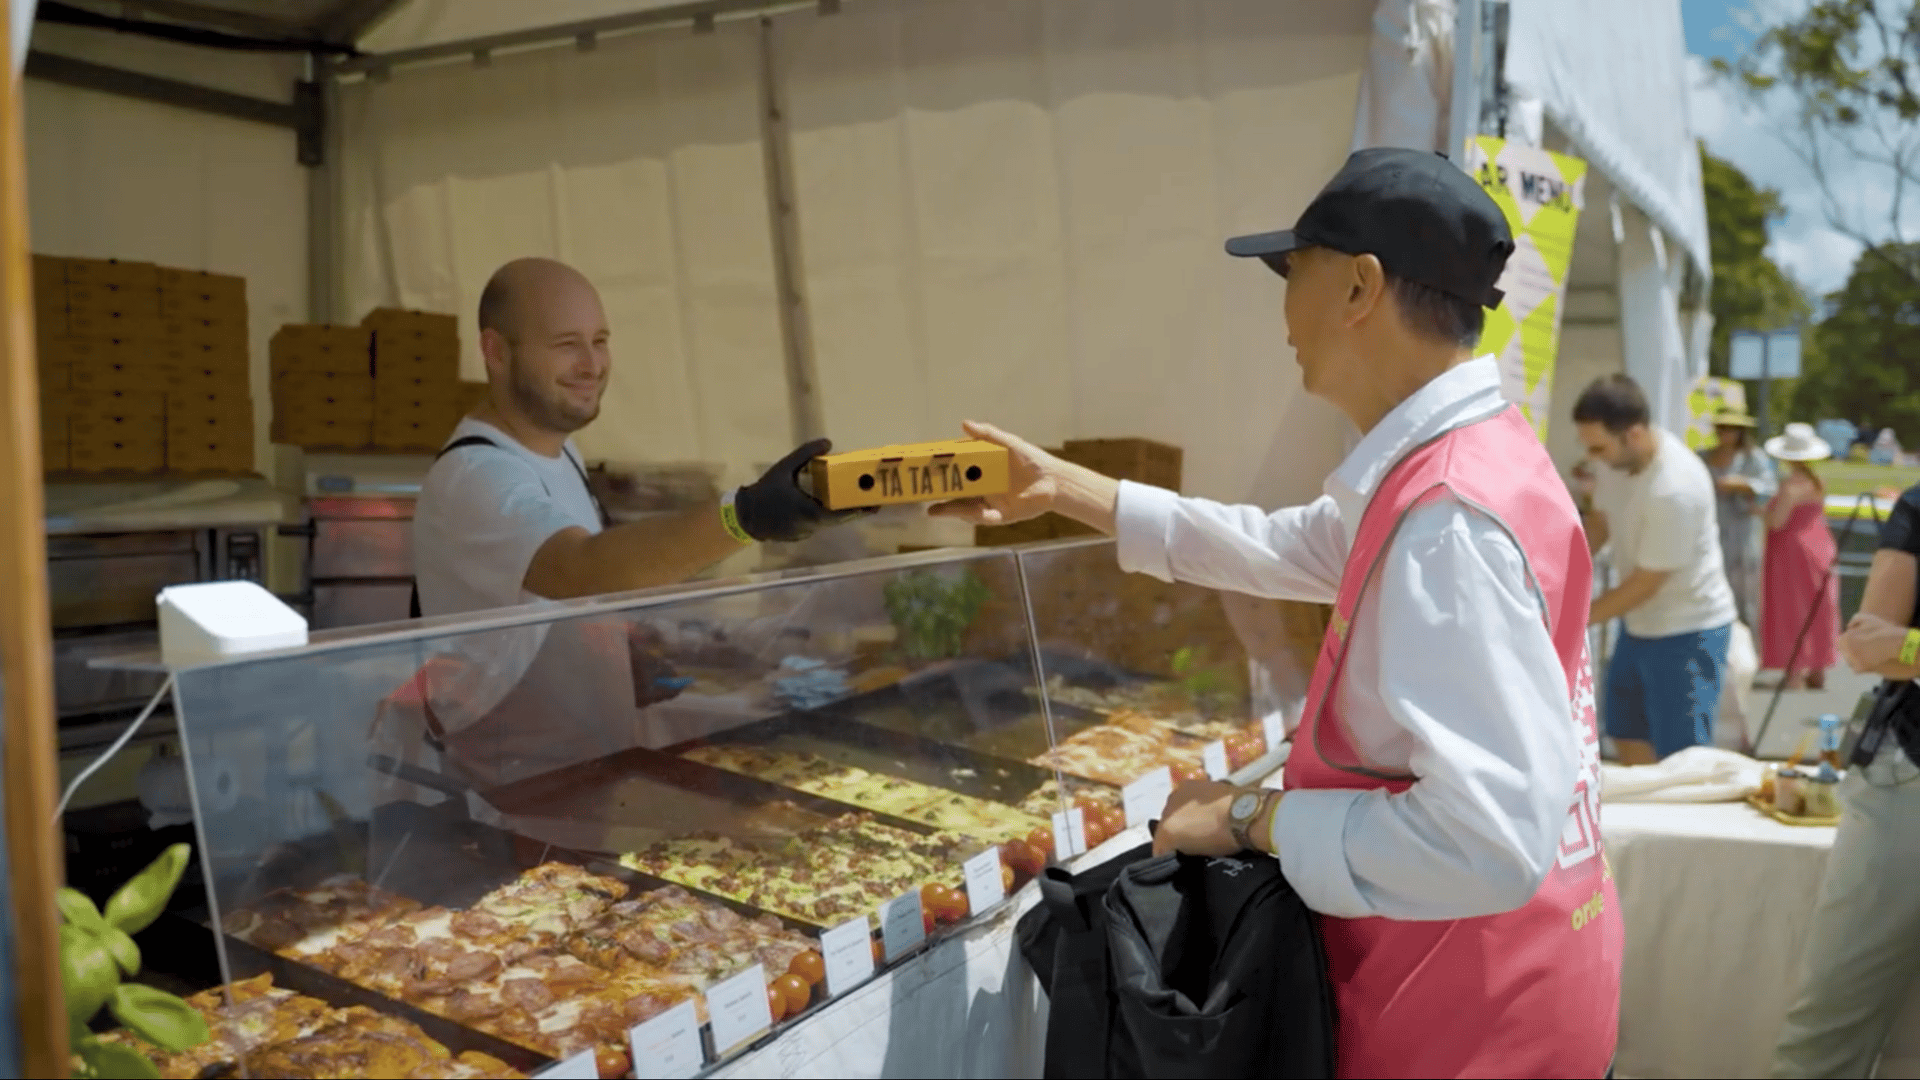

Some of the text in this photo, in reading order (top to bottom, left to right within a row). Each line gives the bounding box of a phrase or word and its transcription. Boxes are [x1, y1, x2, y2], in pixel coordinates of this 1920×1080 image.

[879, 463, 963, 497] TA TA TA
